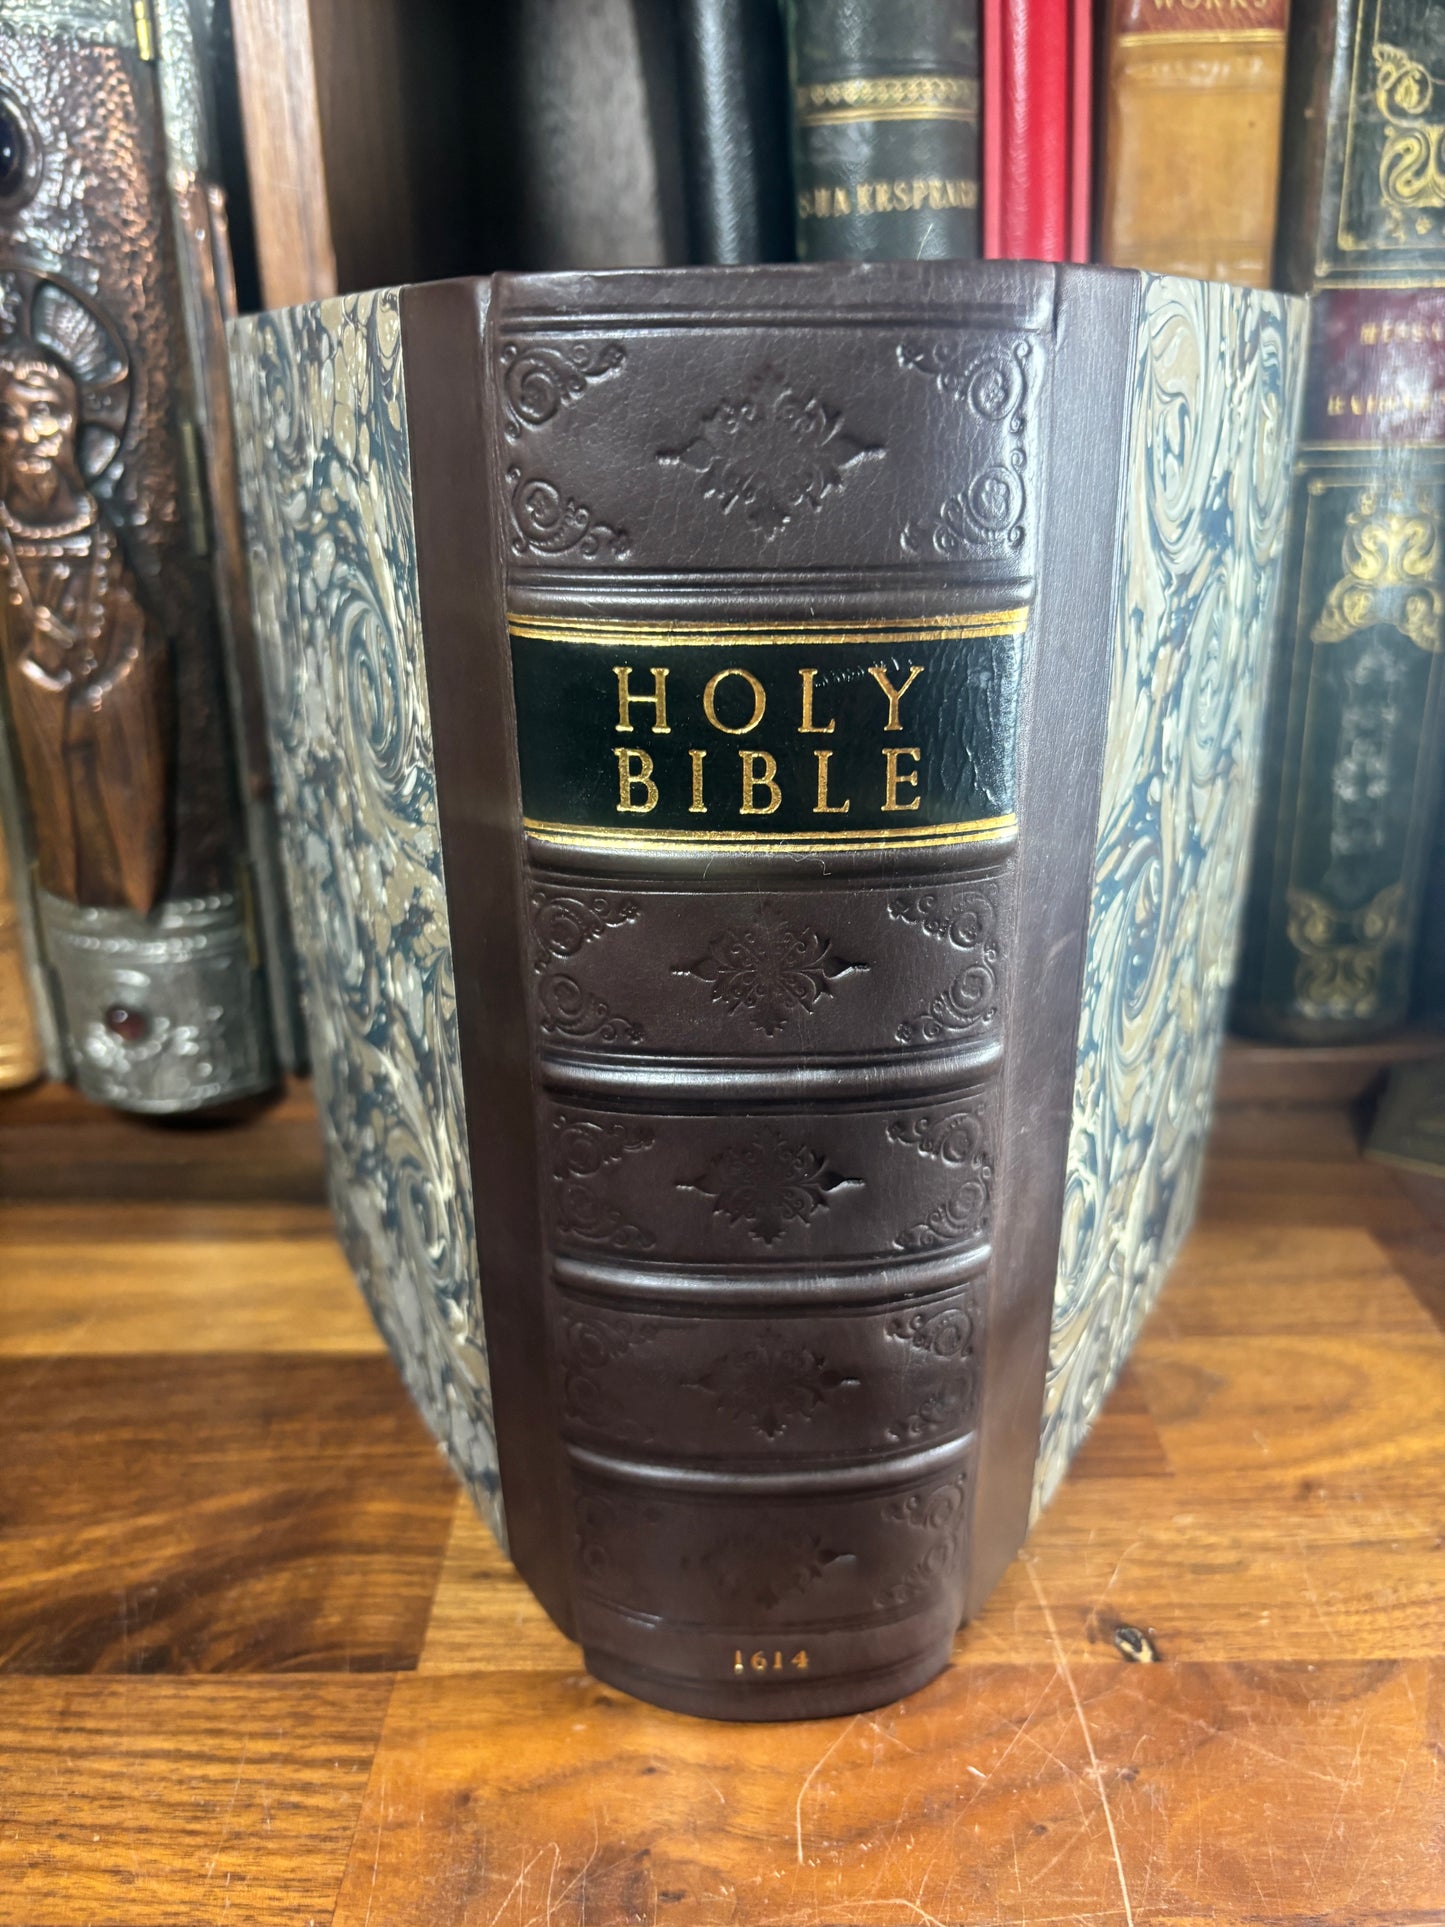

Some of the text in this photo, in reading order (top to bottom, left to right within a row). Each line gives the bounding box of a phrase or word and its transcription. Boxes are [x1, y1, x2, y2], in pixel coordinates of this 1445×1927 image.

[612, 666, 925, 735] HOLY
[612, 747, 921, 815] BIBLE
[734, 1650, 809, 1674] 1614
